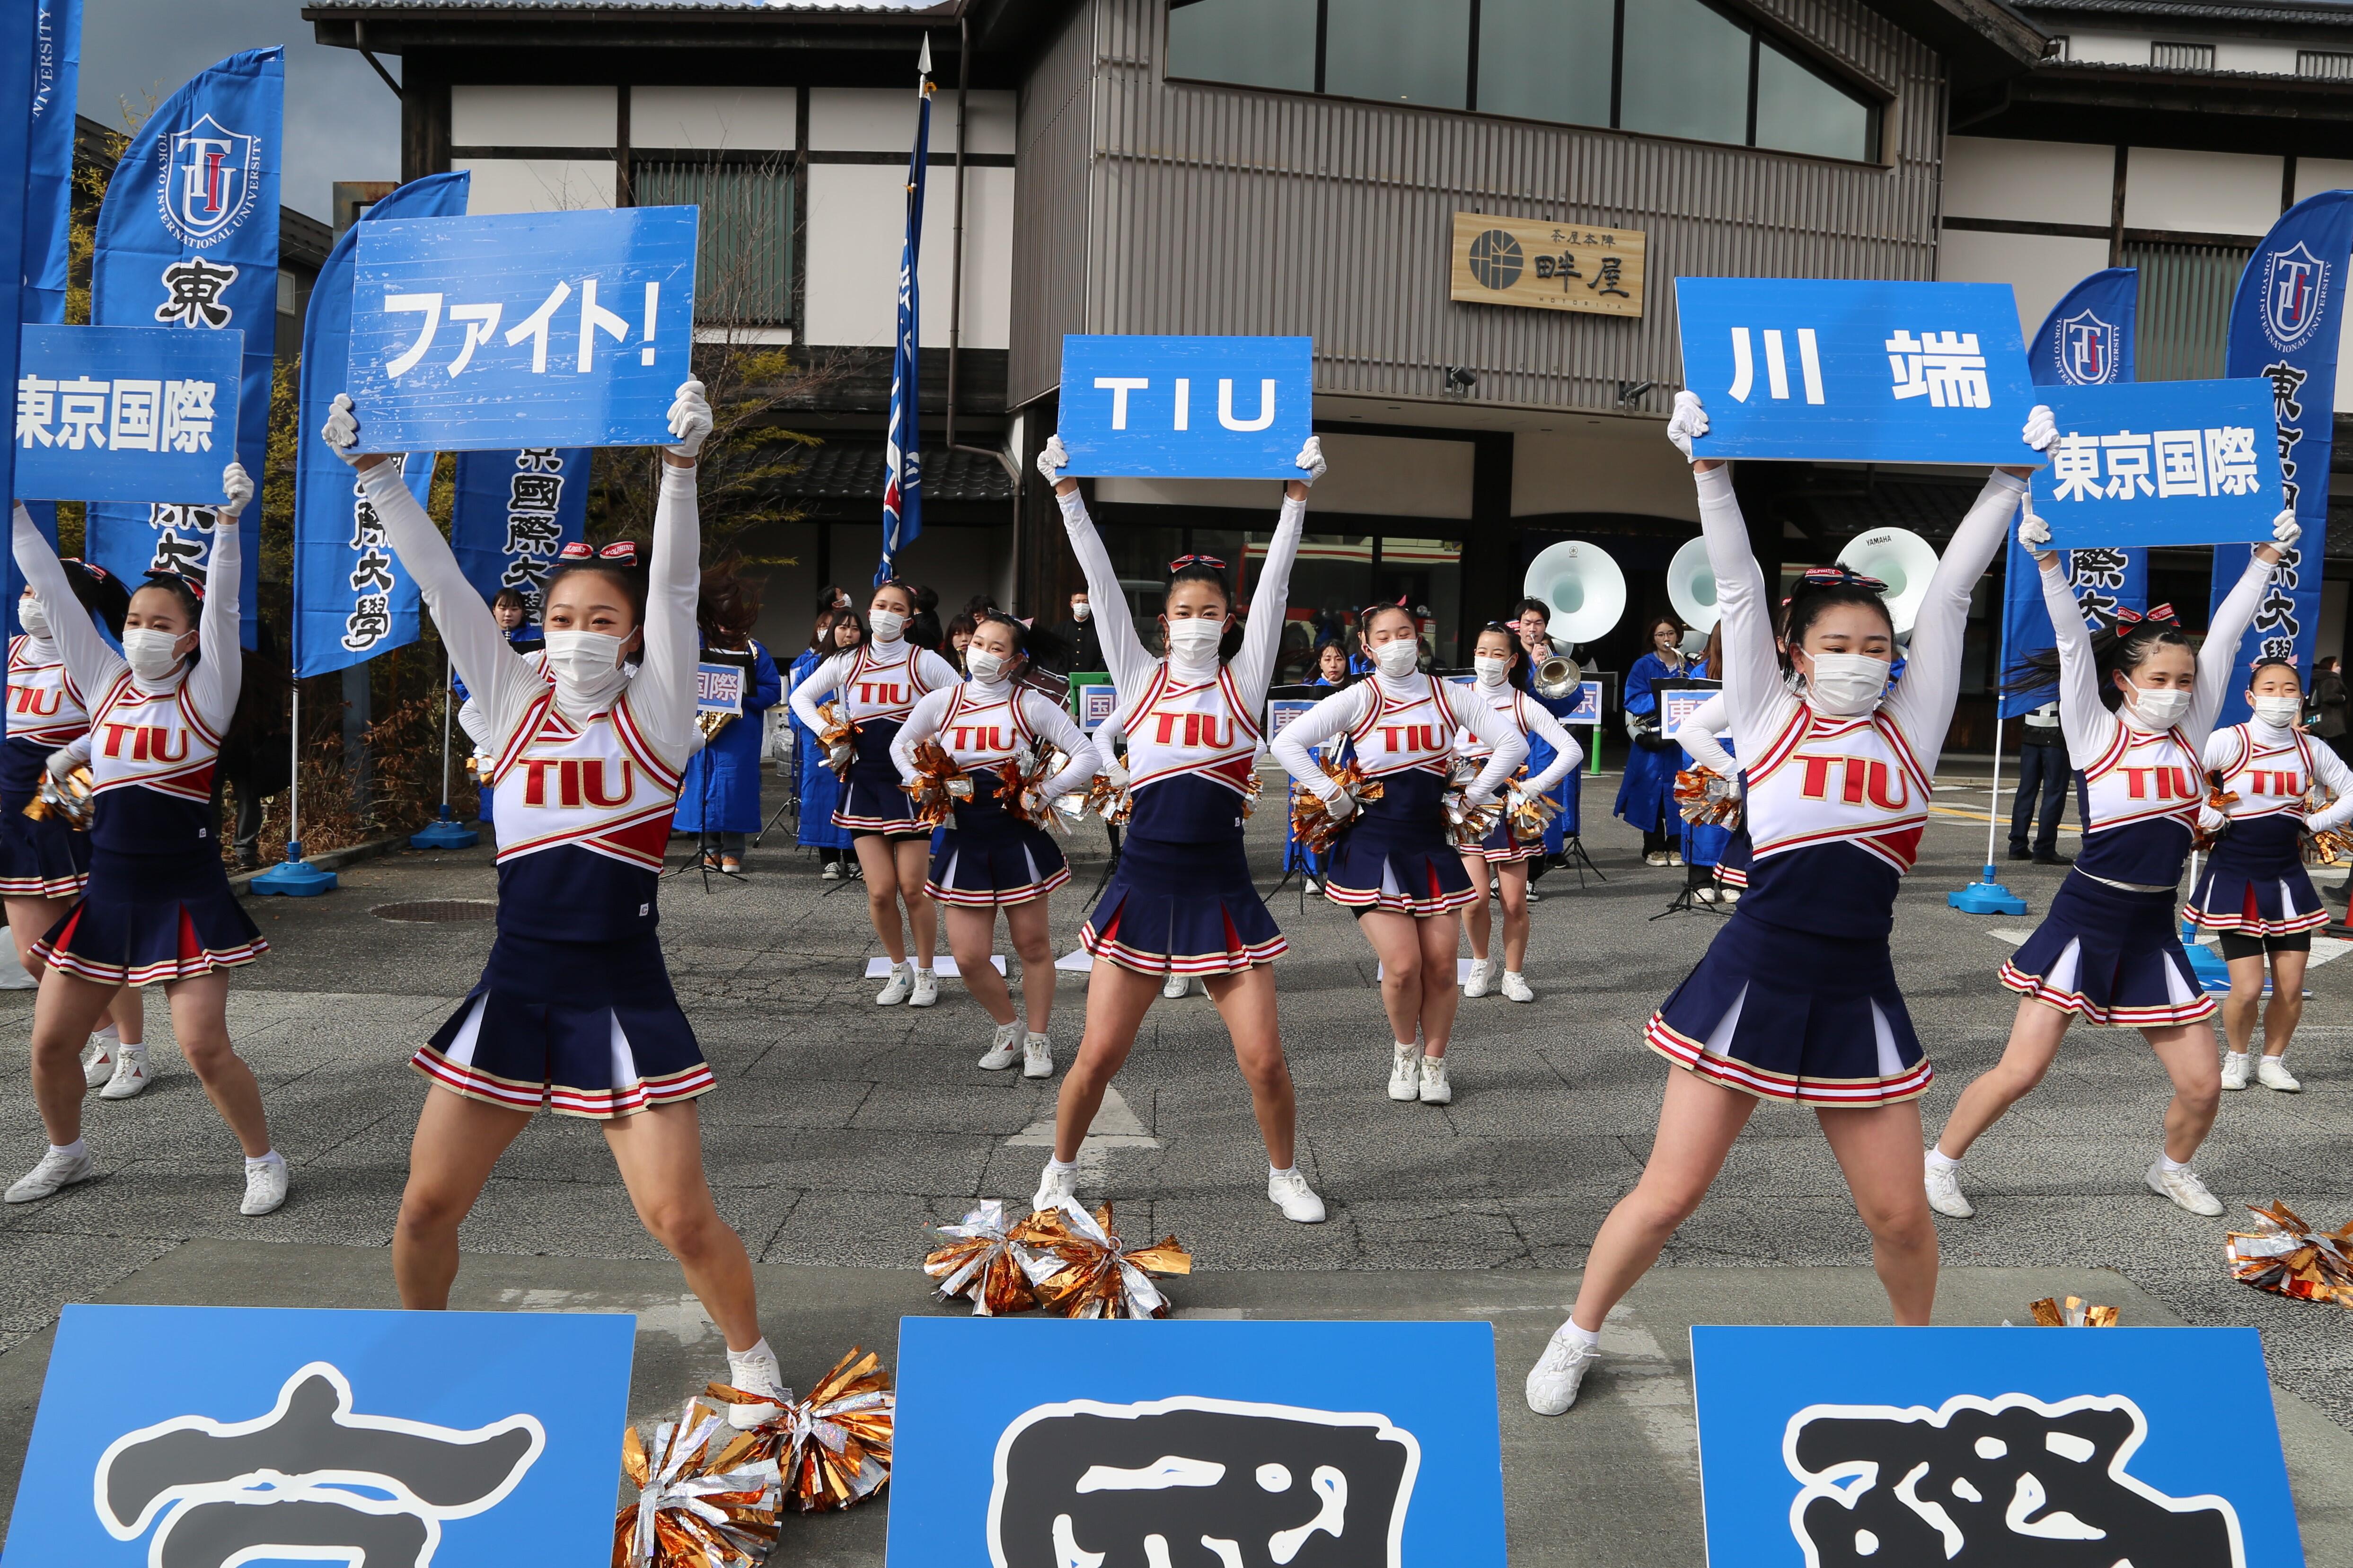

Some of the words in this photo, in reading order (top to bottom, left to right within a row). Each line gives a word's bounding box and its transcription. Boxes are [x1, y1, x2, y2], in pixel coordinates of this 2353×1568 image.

[31, 8, 52, 122] NIVERSITY
[158, 132, 168, 184] TOKYO
[232, 135, 262, 228] UNIVERSITY
[157, 188, 235, 249] INTERNATIONAL
[2261, 250, 2273, 295] TOKYO
[2307, 261, 2332, 337] UNIVERSITY
[1539, 297, 1622, 309] HOTORIYA
[2259, 299, 2308, 353] INTERNATIONAL
[1728, 326, 1992, 409] 川端
[2054, 318, 2062, 354] TOKYO
[2107, 325, 2120, 384] UNIVERSITY
[15, 373, 217, 454] 東京国際
[1093, 377, 1276, 432] TIU
[2052, 426, 2261, 502] 東京国際
[1866, 535, 1892, 546] YAMAHA
[854, 681, 914, 705] TIU
[1087, 694, 1119, 721] 国
[100, 722, 190, 765] TIU
[949, 724, 1018, 752] TIU
[1149, 709, 1235, 751] TIU
[1376, 723, 1446, 754] TIU
[516, 755, 636, 810] TIU
[1789, 752, 1910, 813] TIU
[2113, 765, 2200, 801] TIU
[2243, 768, 2309, 797] TIU
